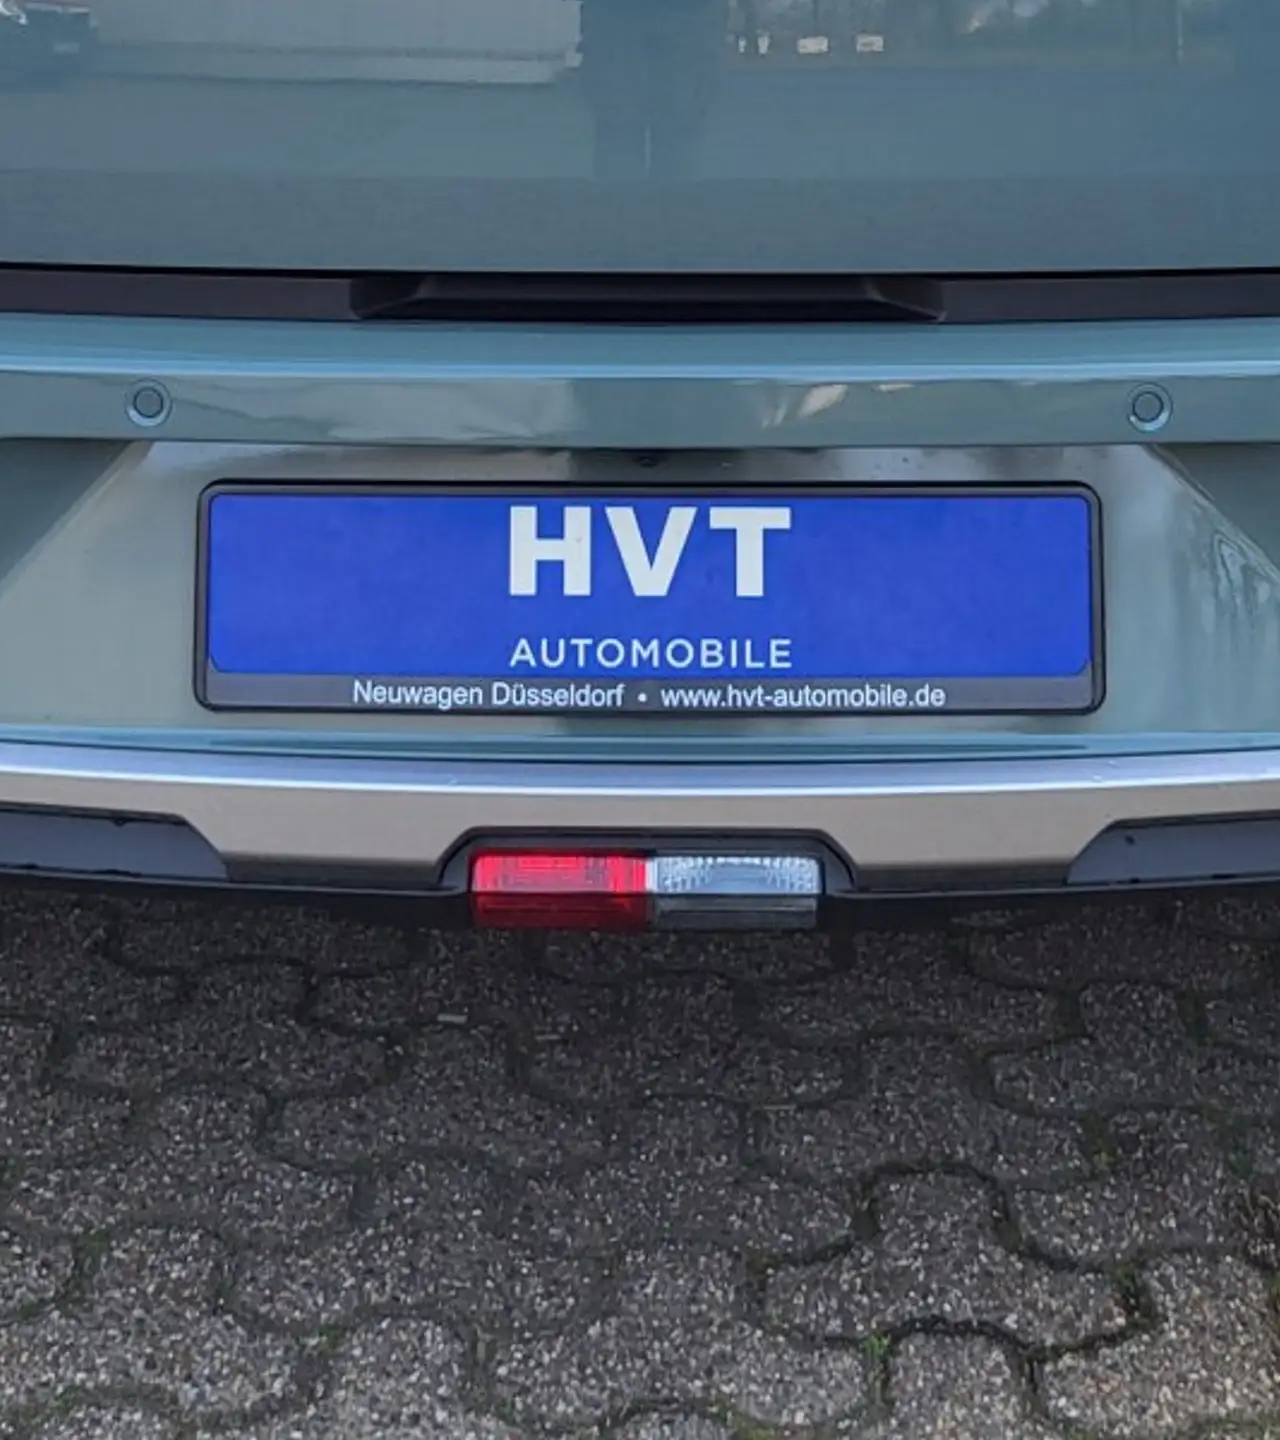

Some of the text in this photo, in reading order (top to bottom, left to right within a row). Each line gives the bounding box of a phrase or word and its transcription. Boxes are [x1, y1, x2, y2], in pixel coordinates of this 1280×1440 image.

[509, 505, 792, 597] HVT
[509, 637, 793, 669] AUTOMOBILE
[352, 679, 947, 711] Neuwagen Düsseldorf www.hvt-automobile.de
